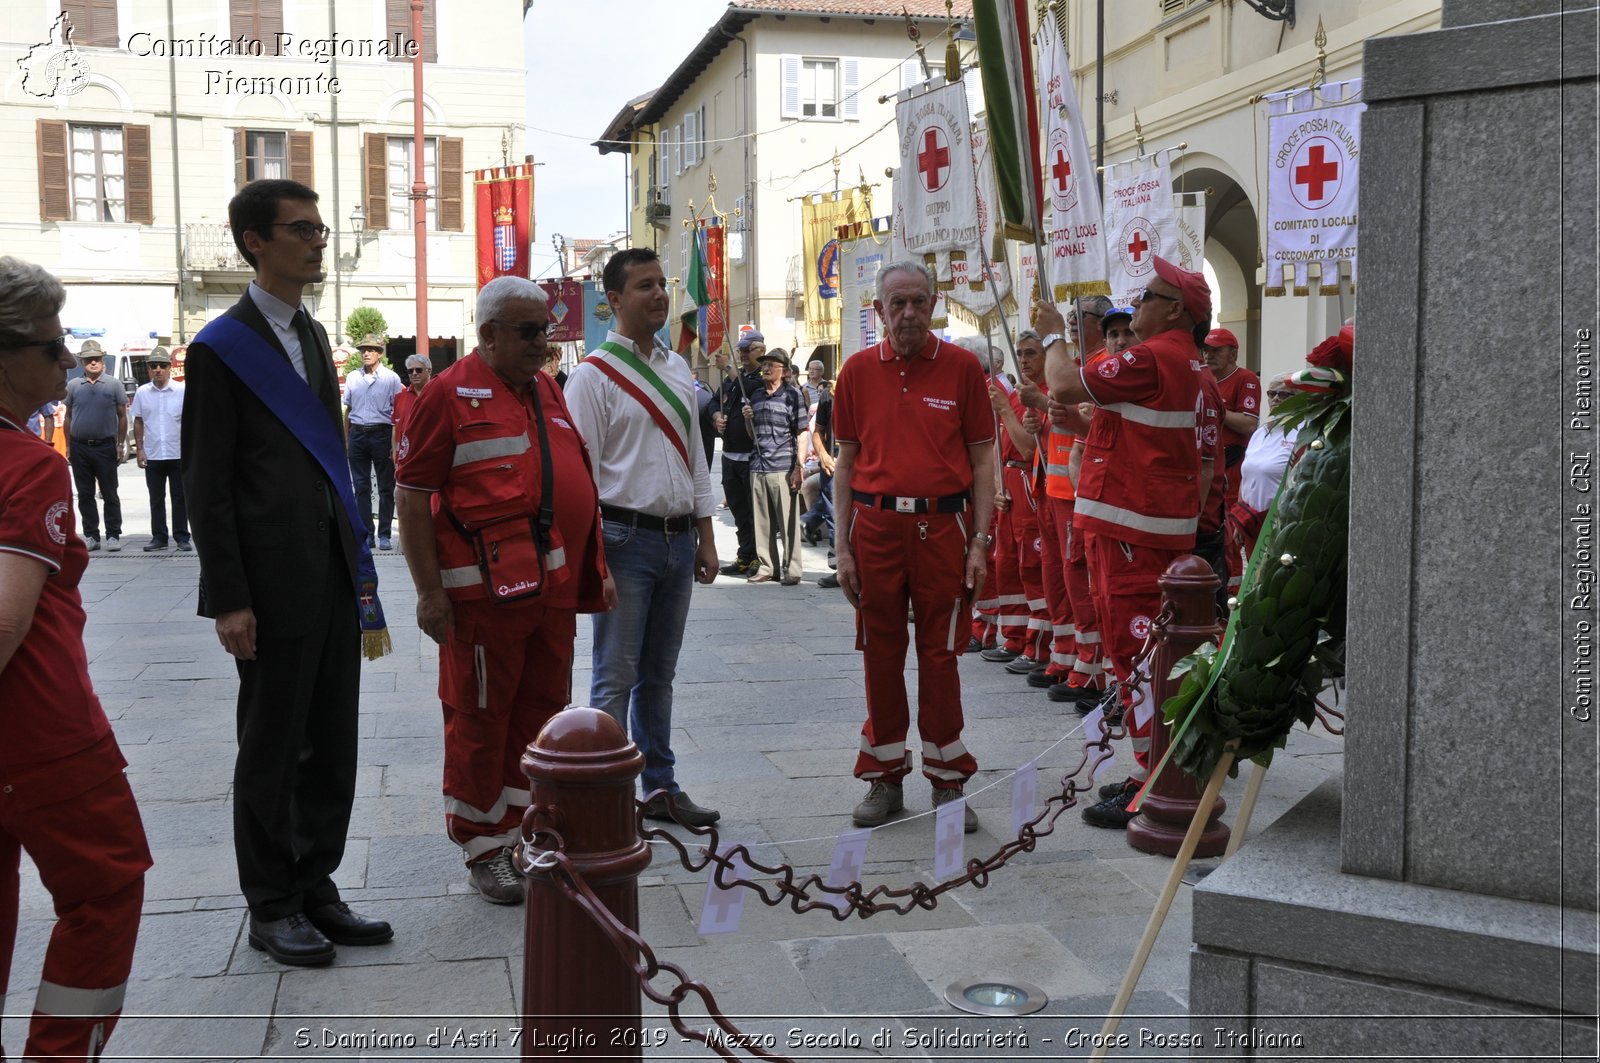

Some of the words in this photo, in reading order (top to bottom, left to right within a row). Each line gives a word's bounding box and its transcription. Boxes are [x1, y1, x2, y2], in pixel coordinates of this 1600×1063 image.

[902, 121, 917, 157] CROCE
[1276, 130, 1299, 169] CROCE
[1299, 118, 1328, 138] ROSSA
[1329, 119, 1359, 160] ITALIANA
[1113, 186, 1136, 198] CROCE
[1137, 180, 1161, 193] ROSSA
[1121, 194, 1152, 209] ITALIANA
[1274, 218, 1319, 231] COMITATO
[1321, 215, 1357, 228] LOCALE
[1310, 234, 1320, 244] DI
[1055, 243, 1086, 258] MONALE
[1274, 248, 1326, 261] COCCONATO
[1327, 247, 1357, 259] D'AST
[922, 396, 940, 404] CROCE
